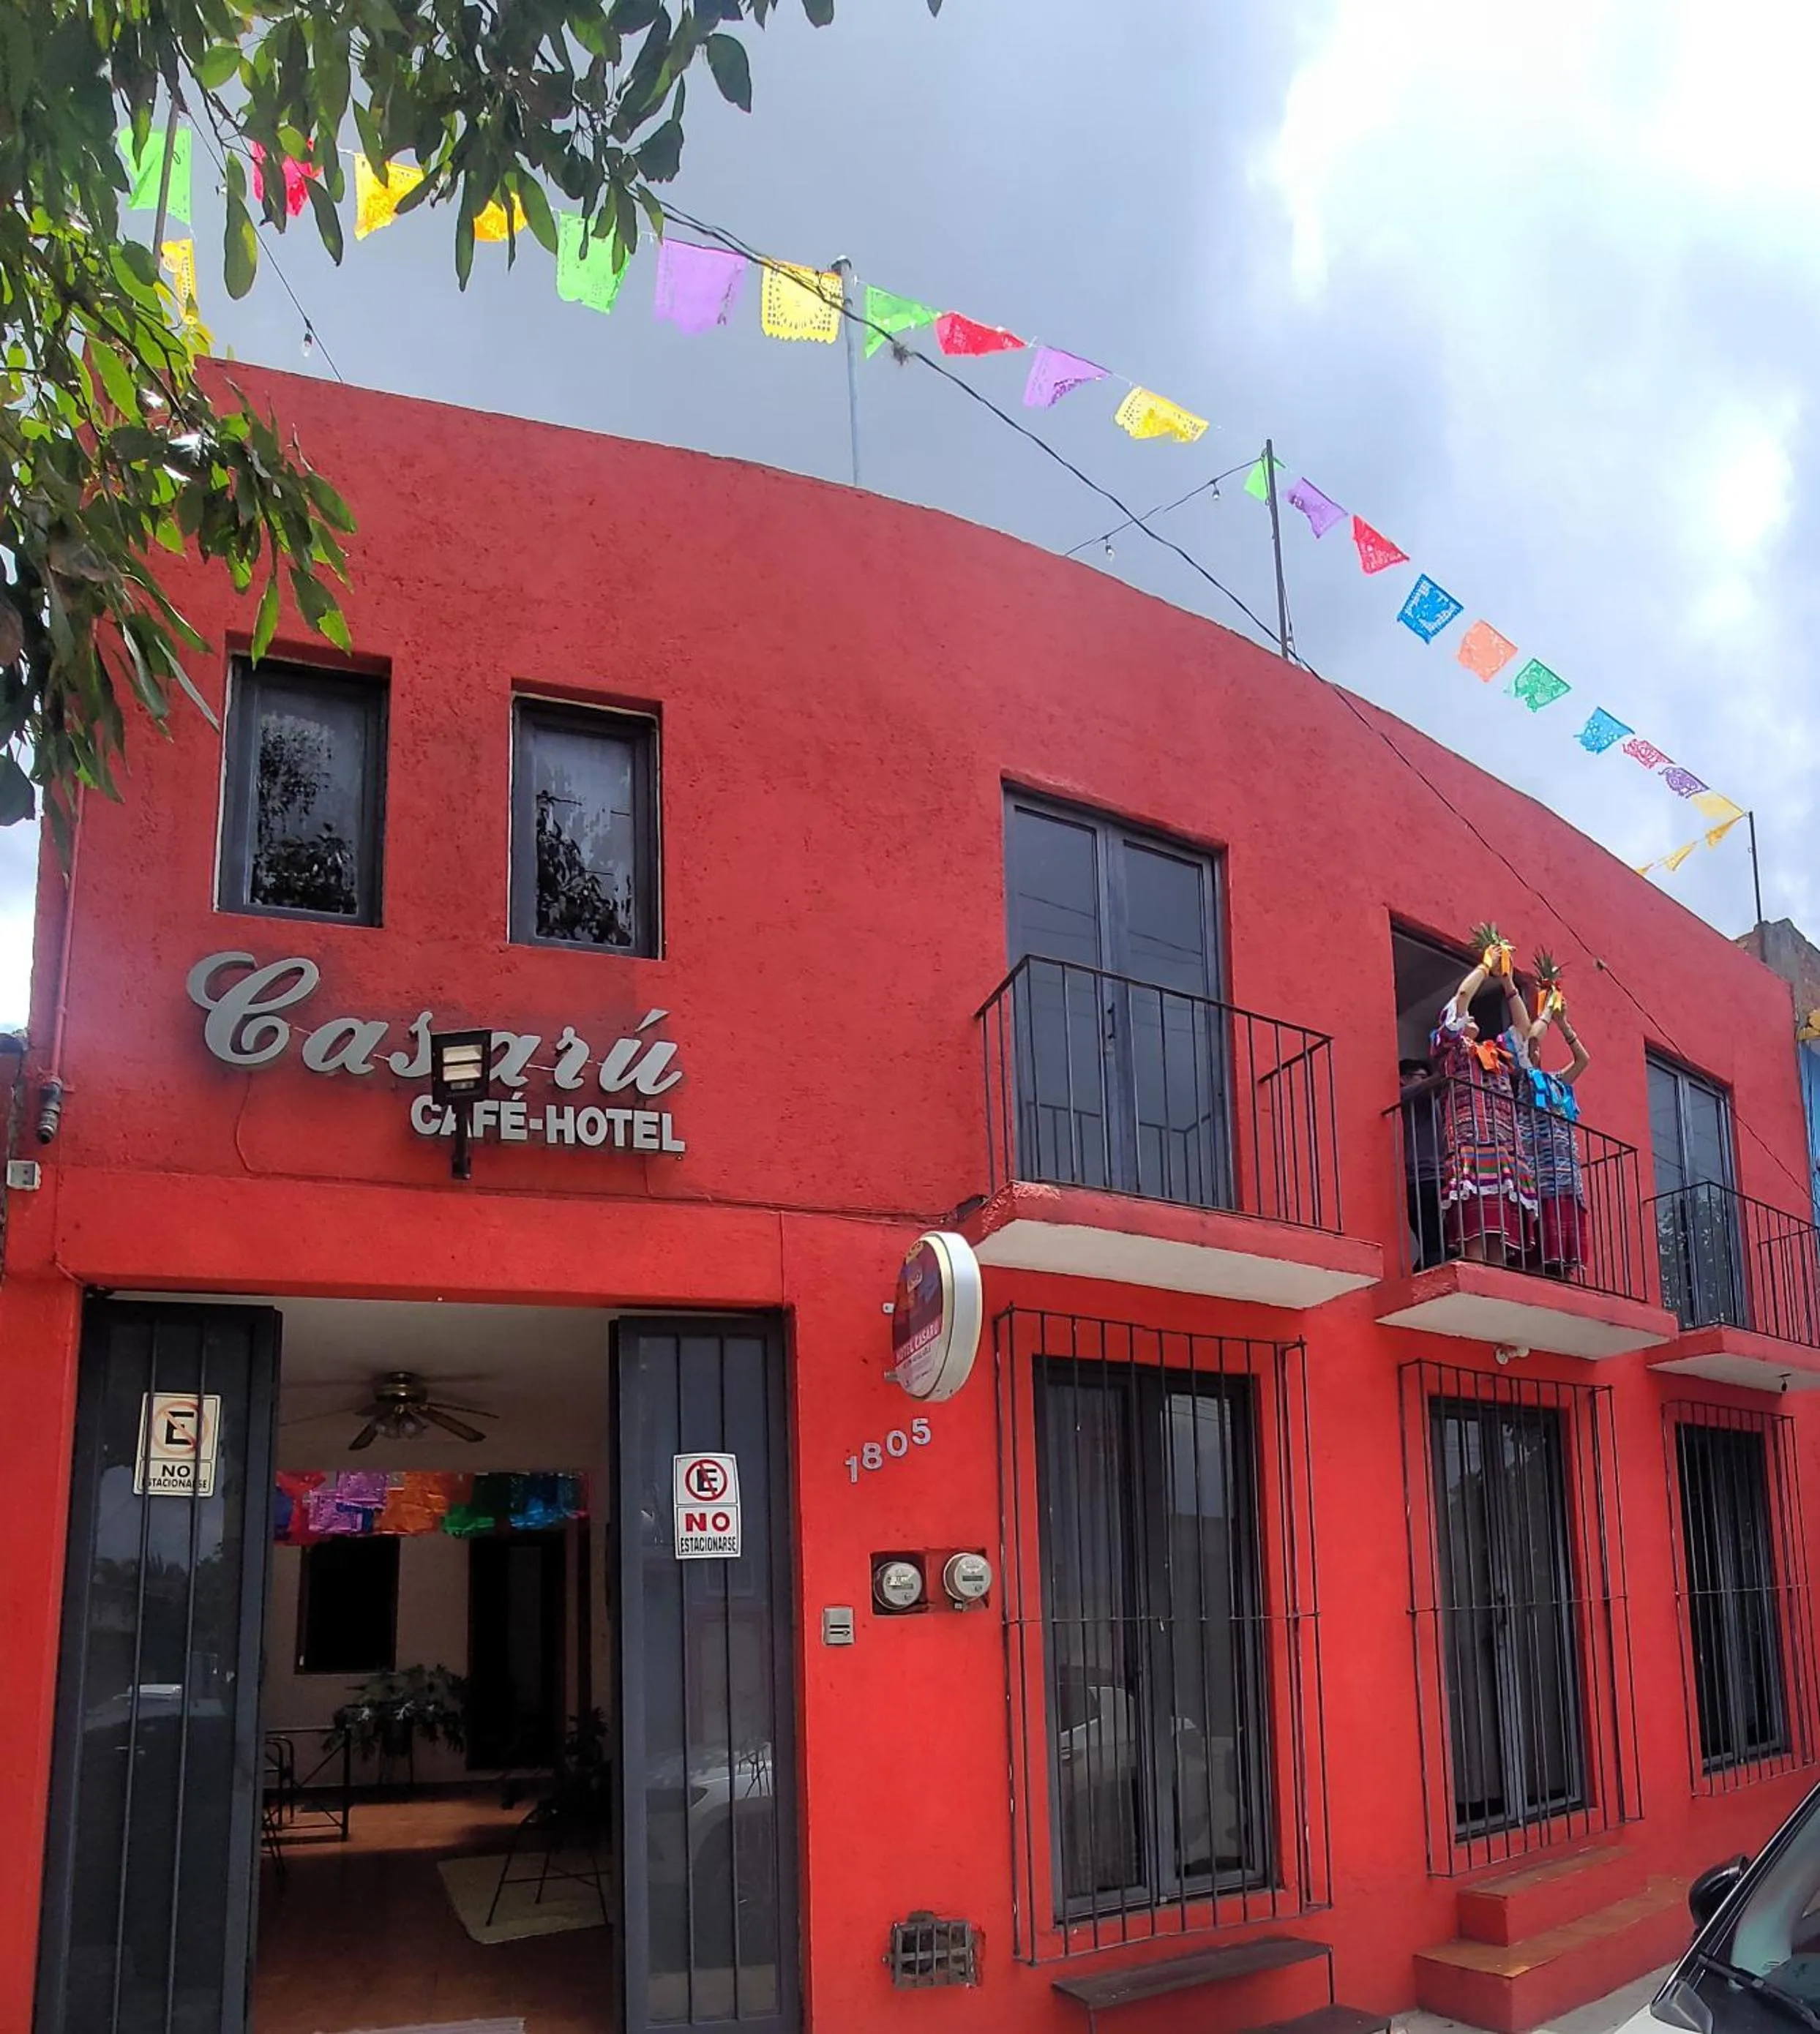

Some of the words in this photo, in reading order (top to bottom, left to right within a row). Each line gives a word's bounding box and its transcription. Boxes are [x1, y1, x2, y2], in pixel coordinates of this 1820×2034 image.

[845, 1417, 932, 1483] 1805
[161, 1464, 191, 1478] NO
[685, 1512, 730, 1532] NO
[681, 1536, 736, 1553] ESTACIONARSE
